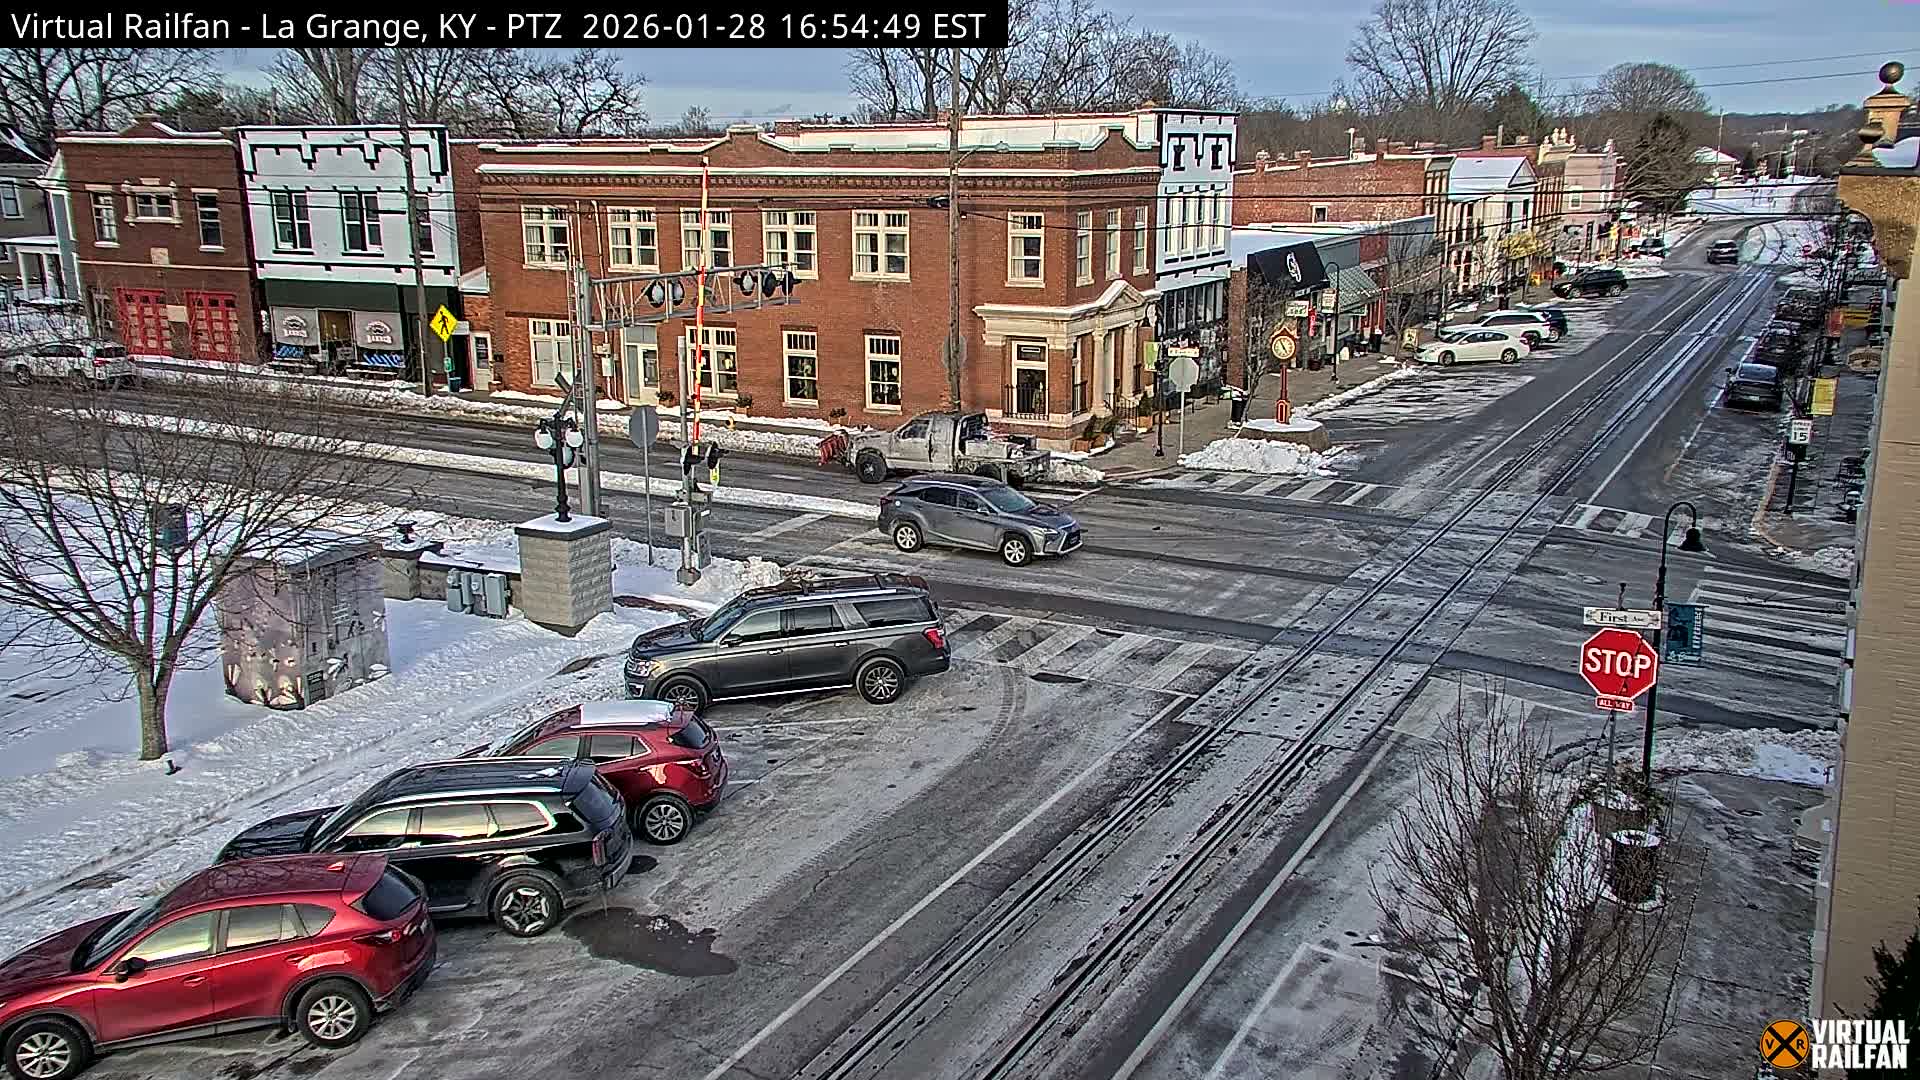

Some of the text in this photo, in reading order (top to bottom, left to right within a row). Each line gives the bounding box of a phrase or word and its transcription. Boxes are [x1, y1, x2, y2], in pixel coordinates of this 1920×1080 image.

[1793, 432, 1808, 441] 15
[1600, 611, 1628, 623] First
[1585, 647, 1651, 679] STOP
[1599, 699, 1631, 709] ALL WAY
